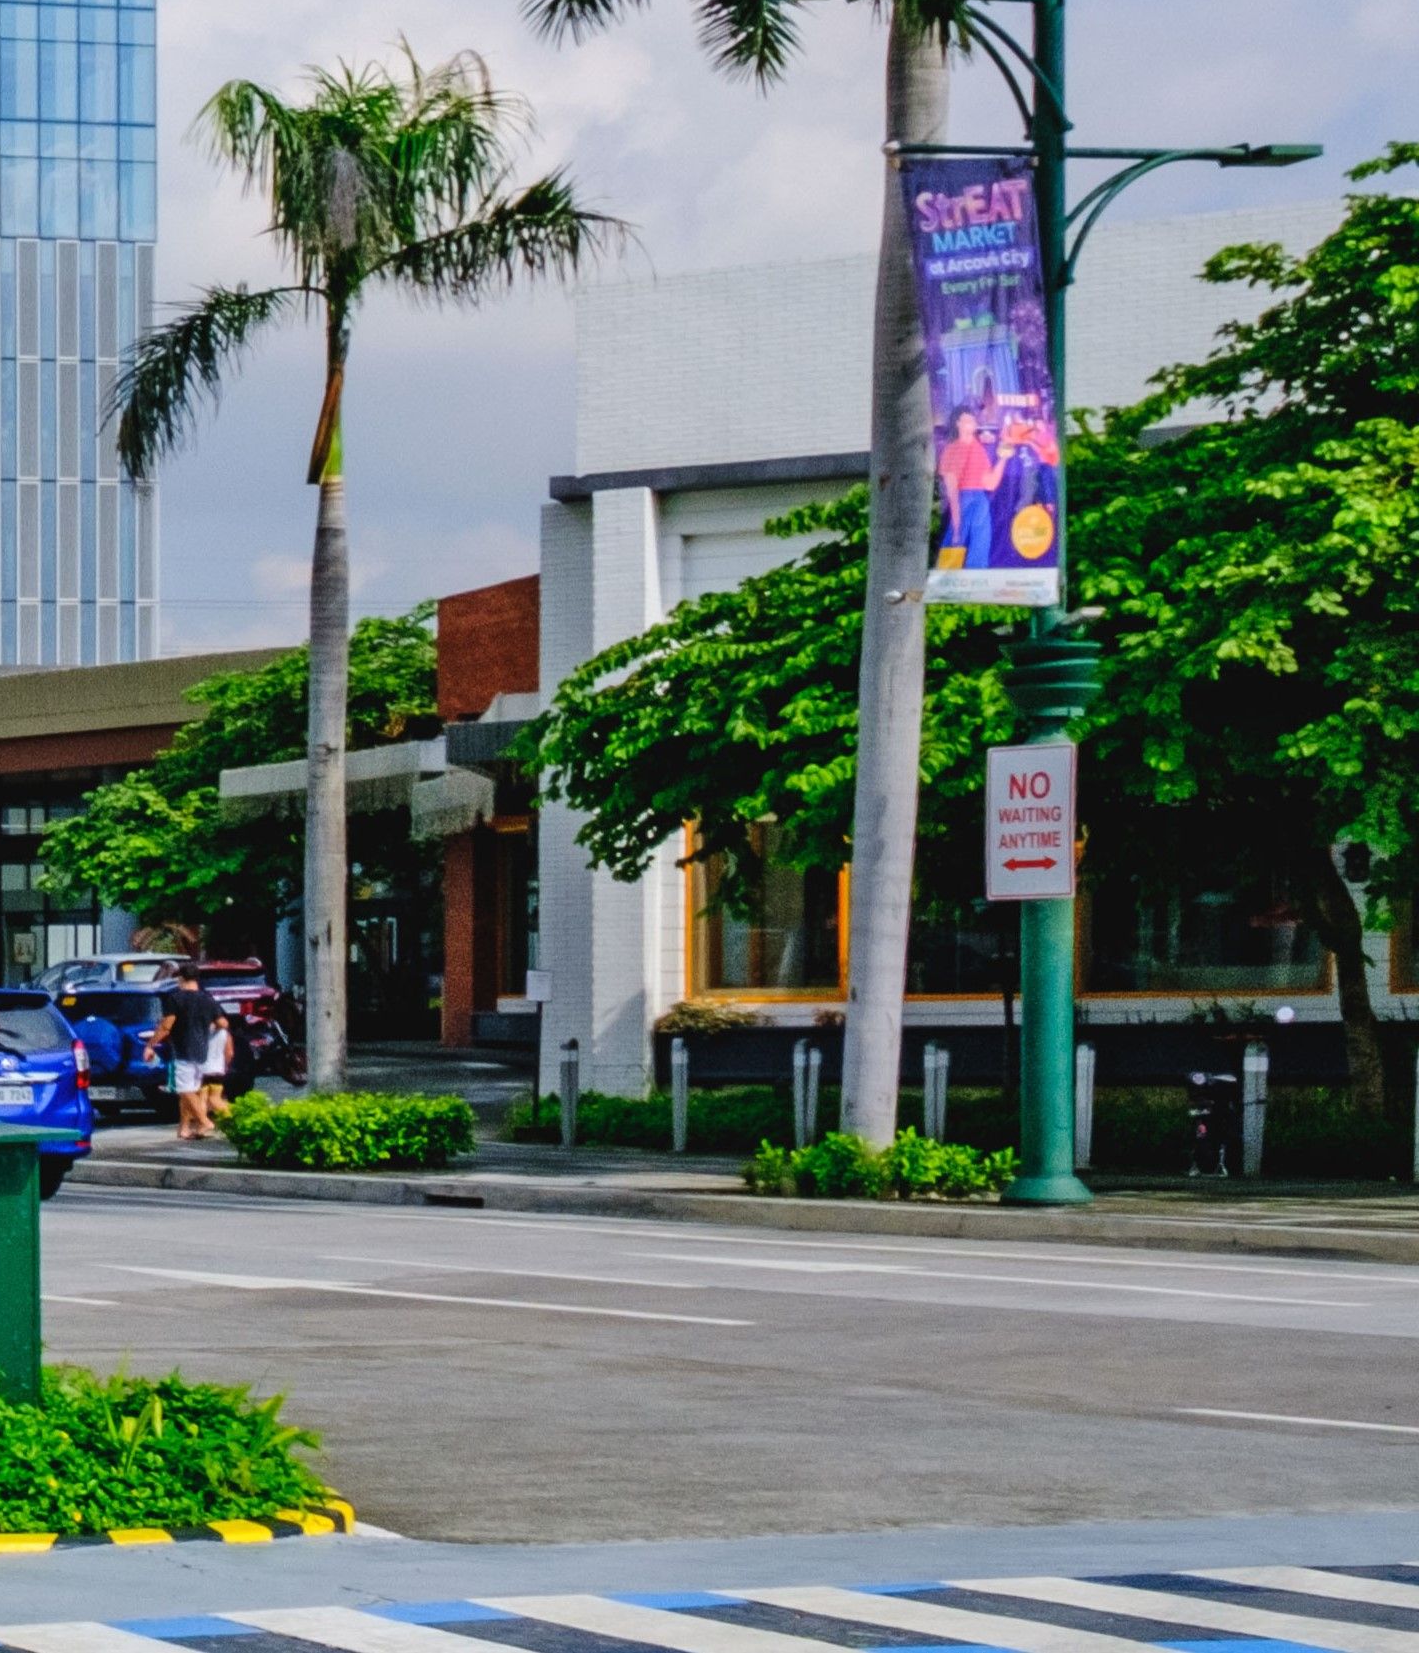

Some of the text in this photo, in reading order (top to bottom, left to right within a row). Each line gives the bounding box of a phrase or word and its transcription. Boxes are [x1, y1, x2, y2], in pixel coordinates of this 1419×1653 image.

[931, 221, 1015, 253] MARKET
[1001, 249, 1030, 268] City
[1009, 771, 1050, 800] NO
[999, 806, 1061, 824] WAITING
[999, 831, 1061, 849] ANYTIME
